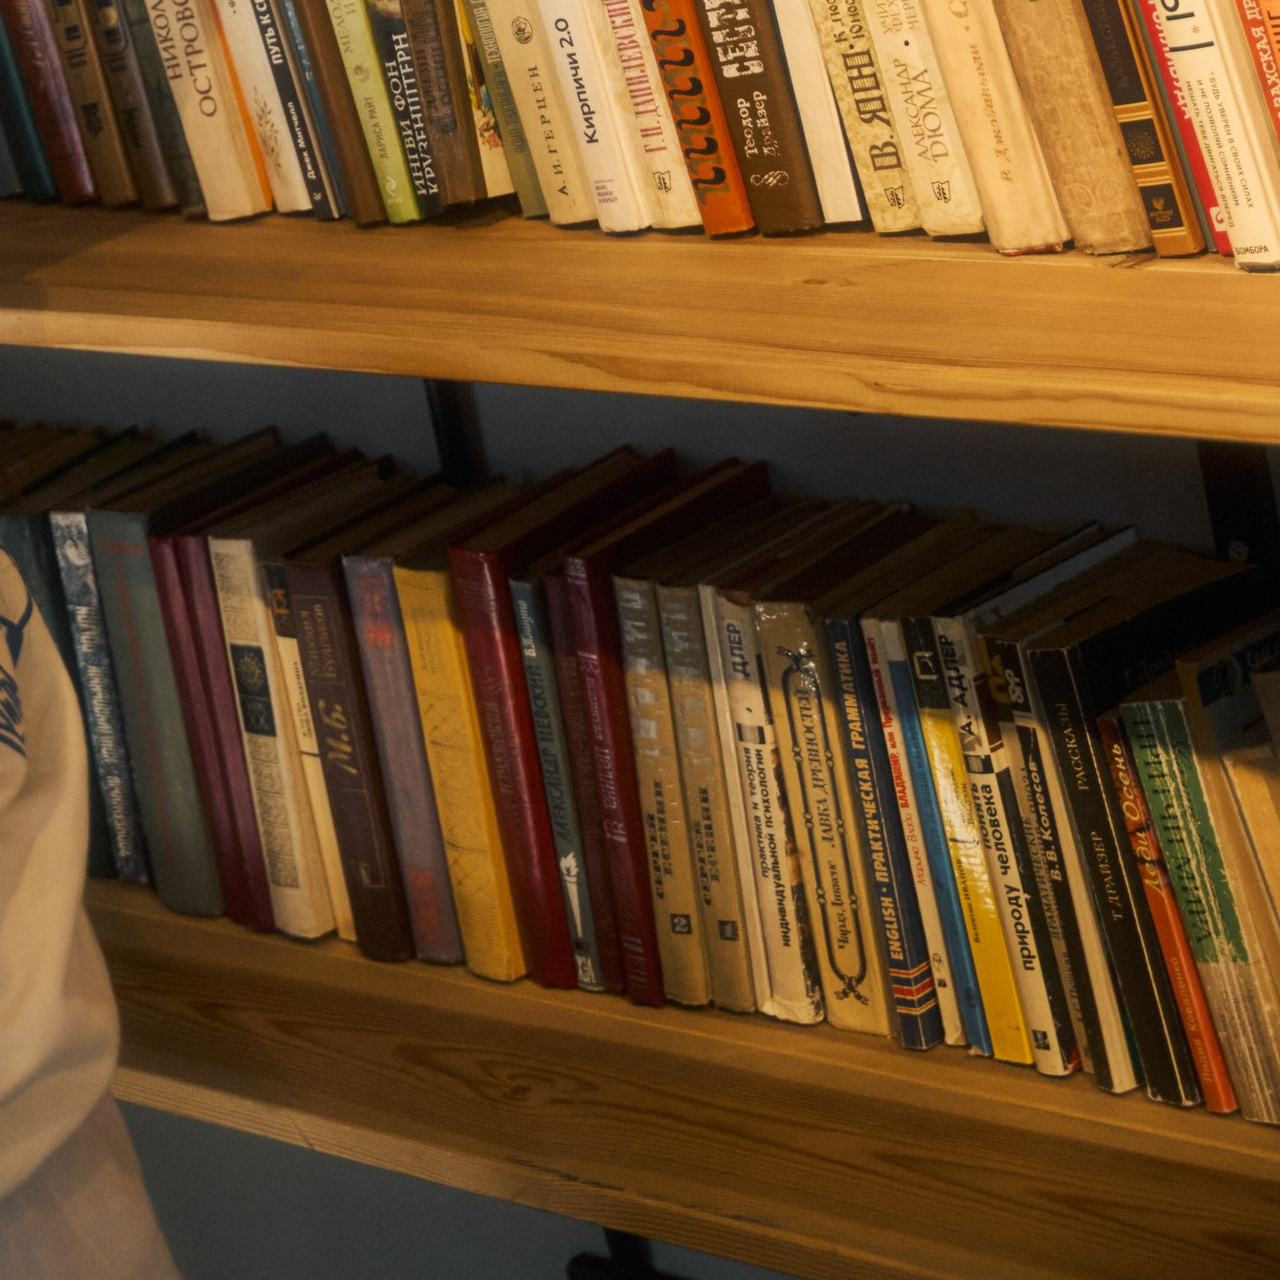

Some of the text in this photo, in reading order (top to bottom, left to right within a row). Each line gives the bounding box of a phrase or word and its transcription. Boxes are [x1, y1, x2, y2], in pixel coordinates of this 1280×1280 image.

[262, 26, 285, 65] ПУТЬ
[473, 5, 499, 64] ТЕХНОЛОГИЯ
[554, 15, 574, 49] 2.0
[285, 99, 308, 151] Митчелл
[391, 58, 408, 111] ФОН
[525, 63, 559, 156] ГЕРЦЕН
[564, 50, 600, 145] Кирпичи
[734, 95, 760, 159] Теодор
[842, 47, 904, 173] В. ЯН
[892, 55, 932, 164] АЛЕКСАНДР
[910, 66, 950, 162] ДЮМА
[1185, 79, 1200, 118] МЕШАТЬ
[1203, 140, 1222, 192] ДВИГАТЬСЯ
[1203, 100, 1221, 150] ПОЗВОЛЯЙ
[1218, 149, 1238, 207] СОМНЕНИЯМ
[1209, 77, 1220, 101] БУДЬ
[1217, 101, 1231, 136] УВЕРЕН
[1230, 144, 1243, 177] СВОИХ
[1240, 177, 1253, 209] СИЛАХ
[1235, 244, 1269, 256] БОМБОРА
[937, 633, 969, 710] АДЛЕР
[1056, 699, 1086, 792] РАССКАЗЫ
[1106, 741, 1141, 824] Осень
[834, 637, 902, 962] ENGLISH ПРАКТИЧЕСКАЯ ГРАММАТИКА
[1027, 759, 1052, 842] Колесов
[752, 746, 793, 949] индивидуальной психологии
[983, 783, 1035, 972] природу человека
[1092, 828, 1118, 909] ДРАЙЗЕР
[1131, 828, 1164, 899] Леди
